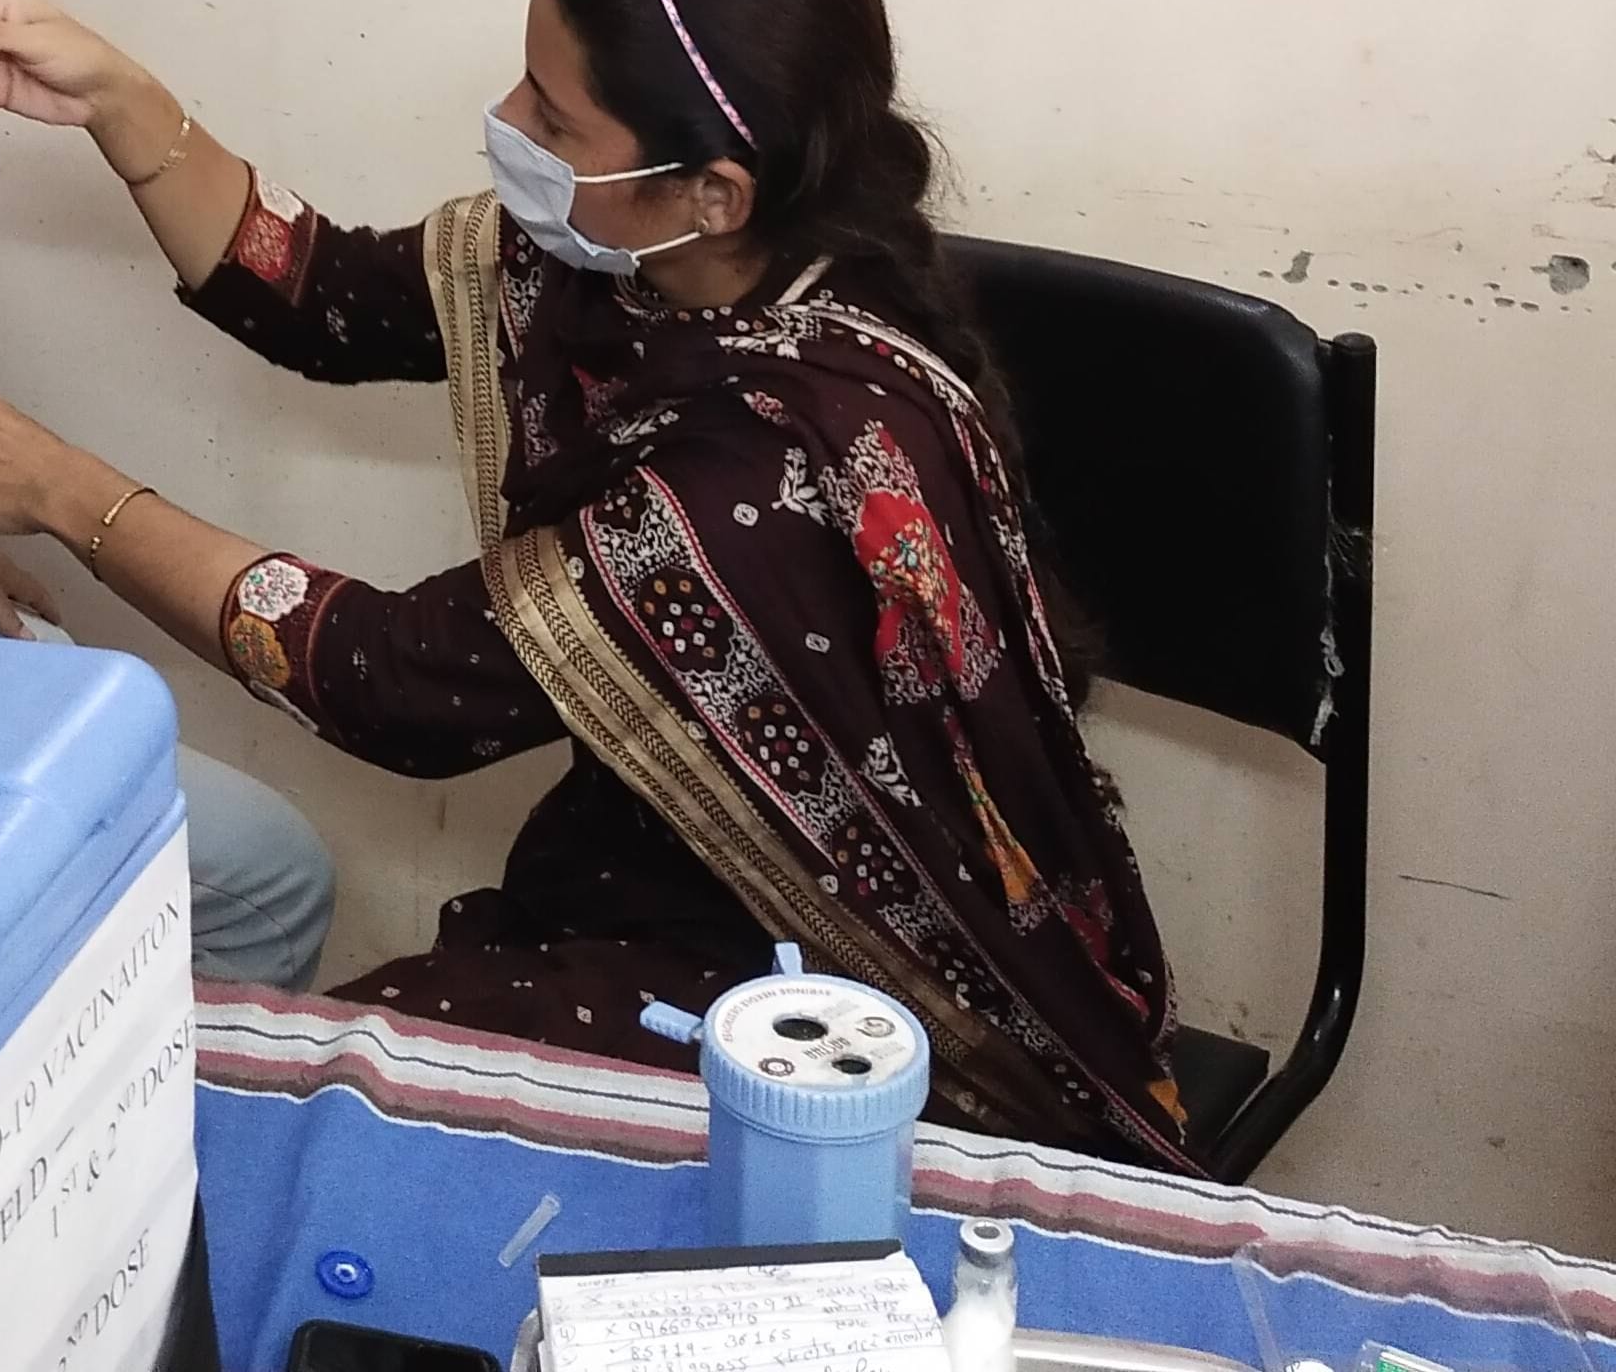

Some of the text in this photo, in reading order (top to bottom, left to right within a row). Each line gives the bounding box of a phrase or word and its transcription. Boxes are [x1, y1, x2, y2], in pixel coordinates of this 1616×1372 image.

[43, 892, 181, 1089] VACINAITON
[86, 1150, 101, 1192] &
[142, 1010, 195, 1108] DOSE
[94, 1228, 151, 1336] DOSE
